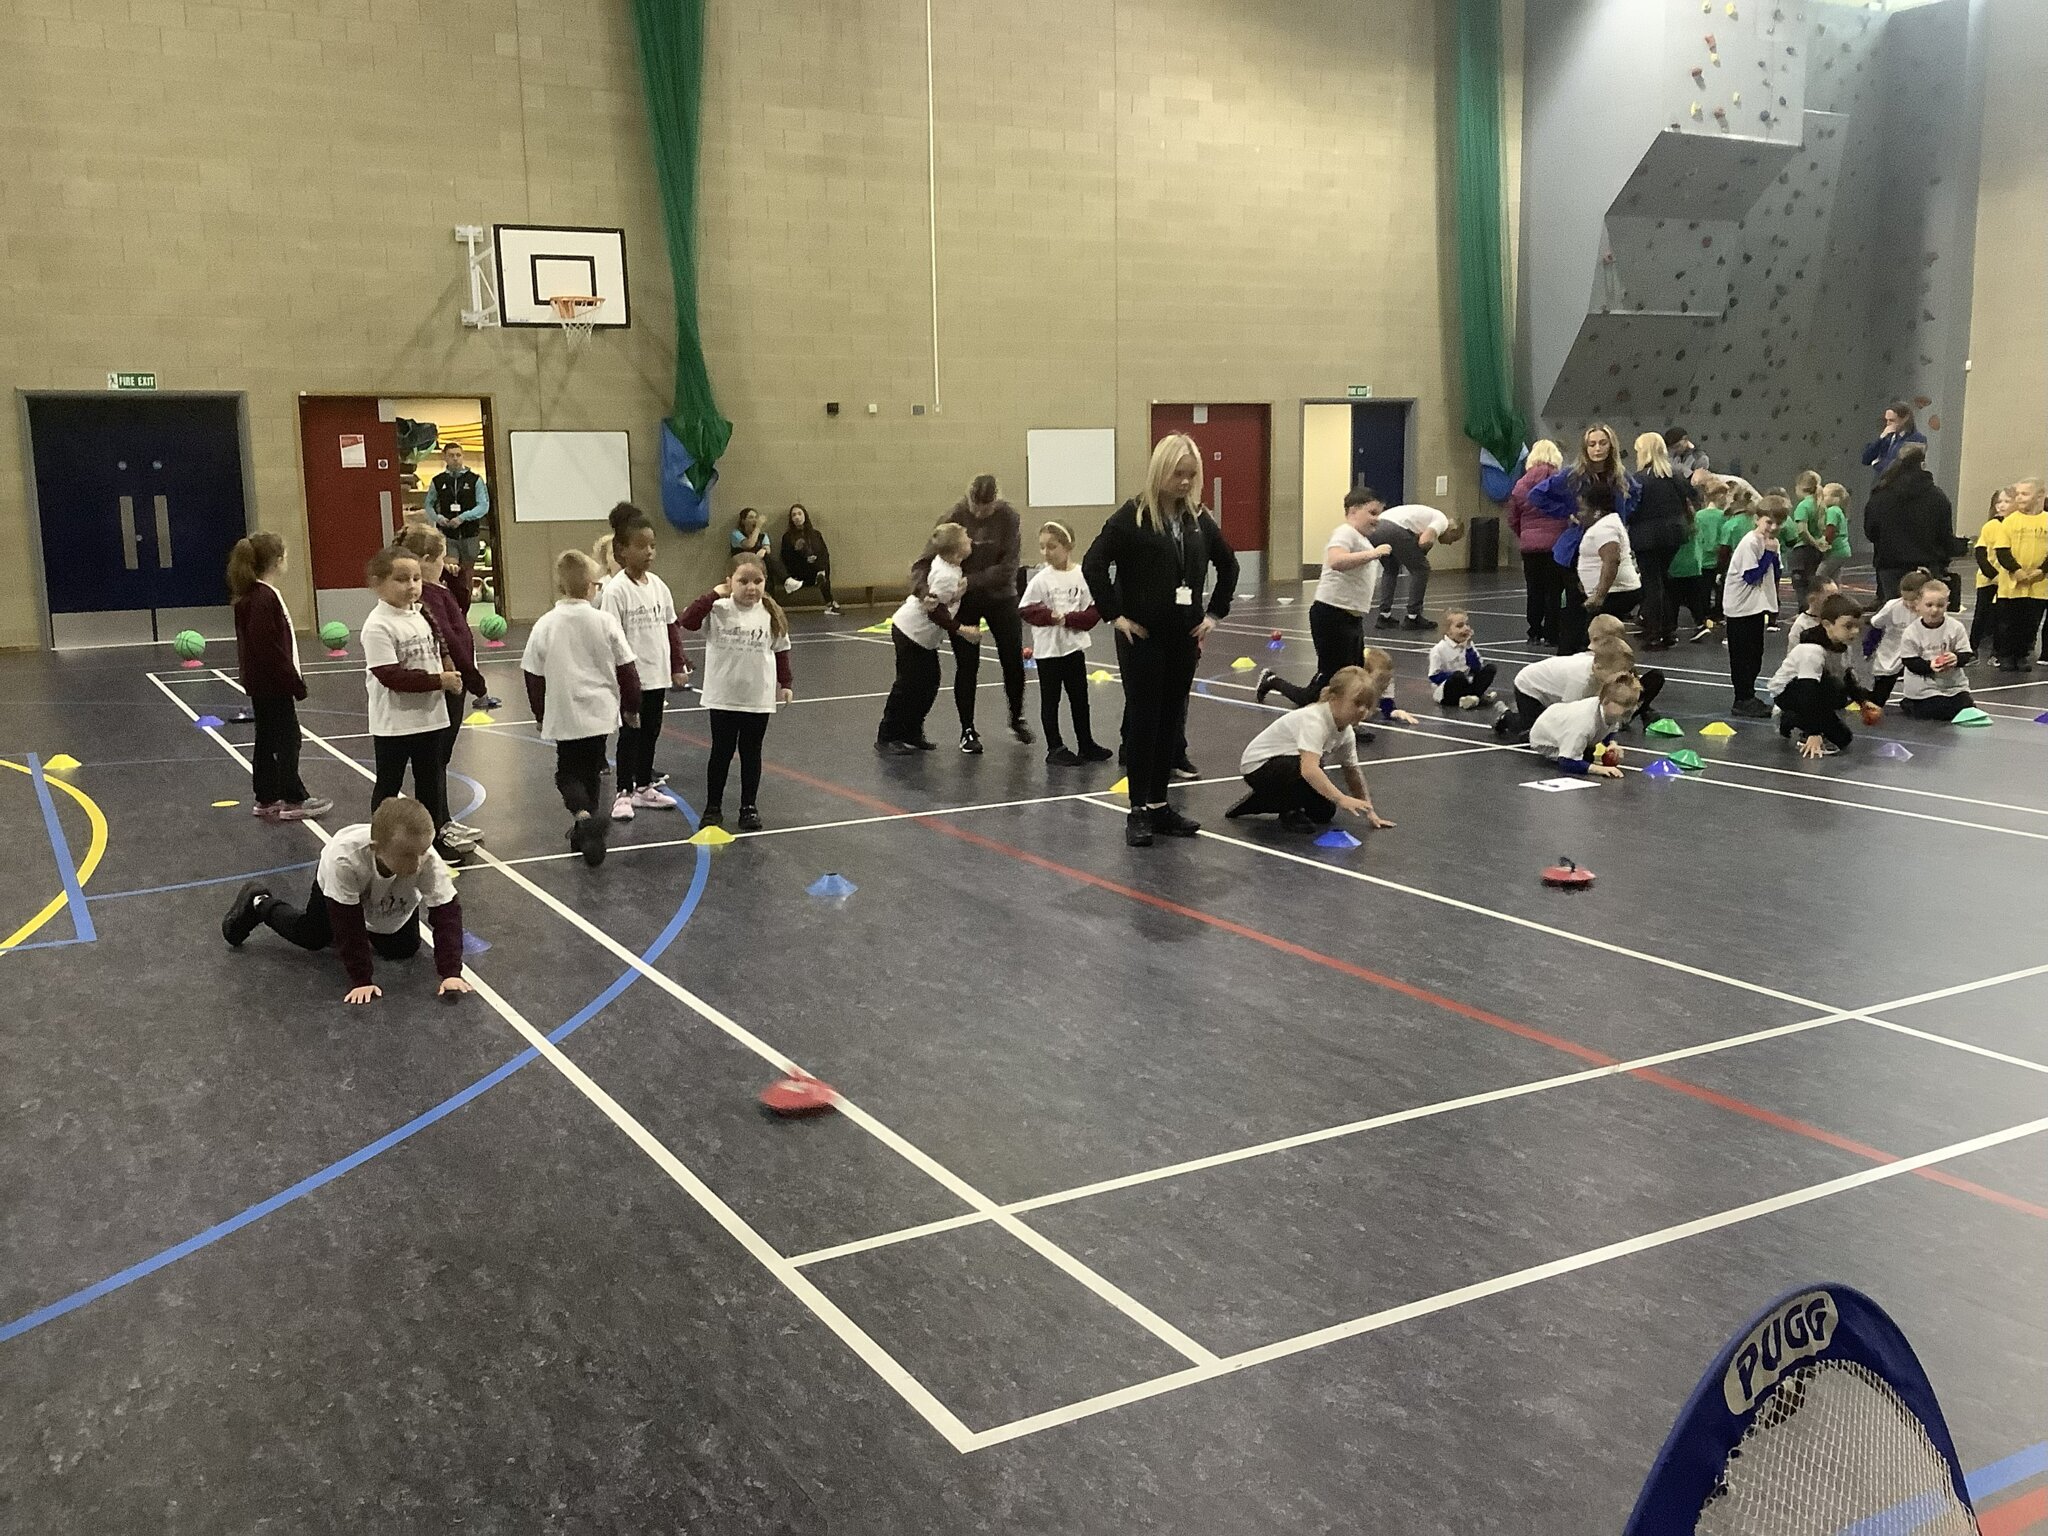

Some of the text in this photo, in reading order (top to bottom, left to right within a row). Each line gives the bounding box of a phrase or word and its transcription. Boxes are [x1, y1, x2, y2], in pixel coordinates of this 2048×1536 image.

[119, 376, 154, 386] FIRE EXIT
[1736, 1298, 1827, 1401] PUGG
